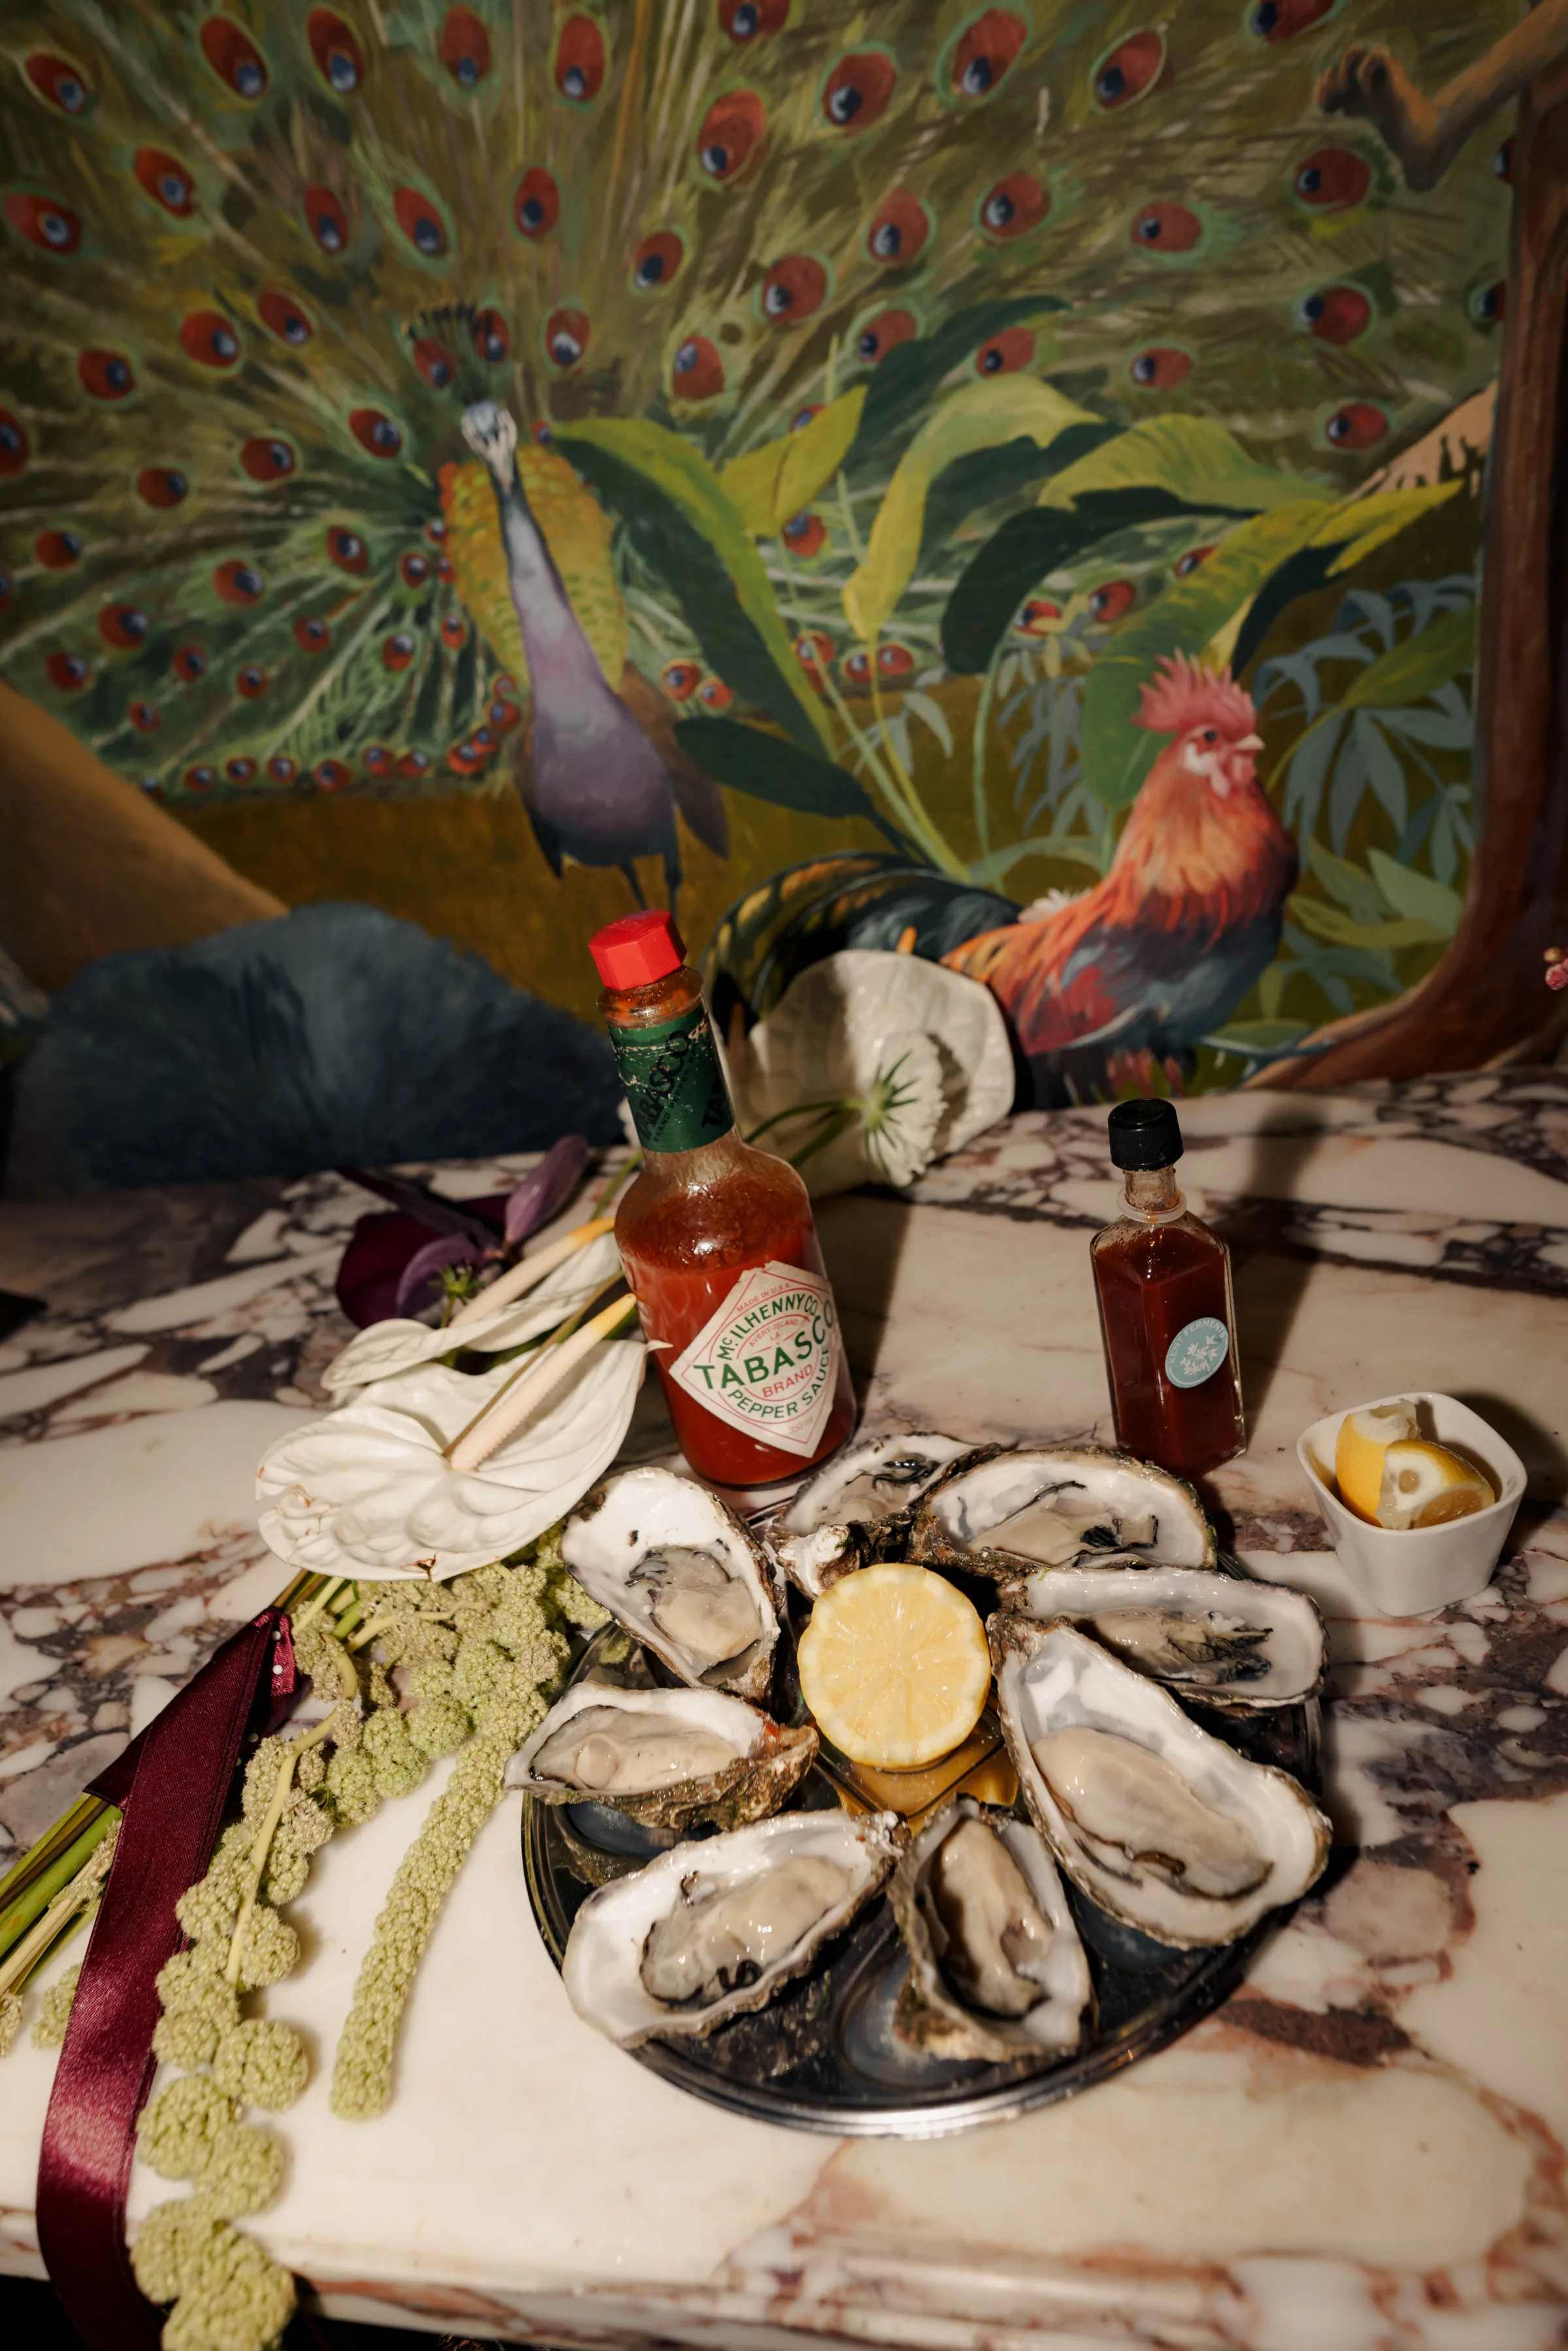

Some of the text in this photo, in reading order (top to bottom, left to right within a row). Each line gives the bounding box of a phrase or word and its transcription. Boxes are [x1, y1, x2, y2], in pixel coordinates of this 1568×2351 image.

[737, 1296, 759, 1312] MADE
[693, 1298, 834, 1390] TABASCO
[749, 1325, 772, 1347] AVERY
[1169, 1319, 1228, 1364] KENT FERMENTS
[728, 1344, 830, 1419] PEPPER SAUCE
[762, 1364, 813, 1398] BRAND
